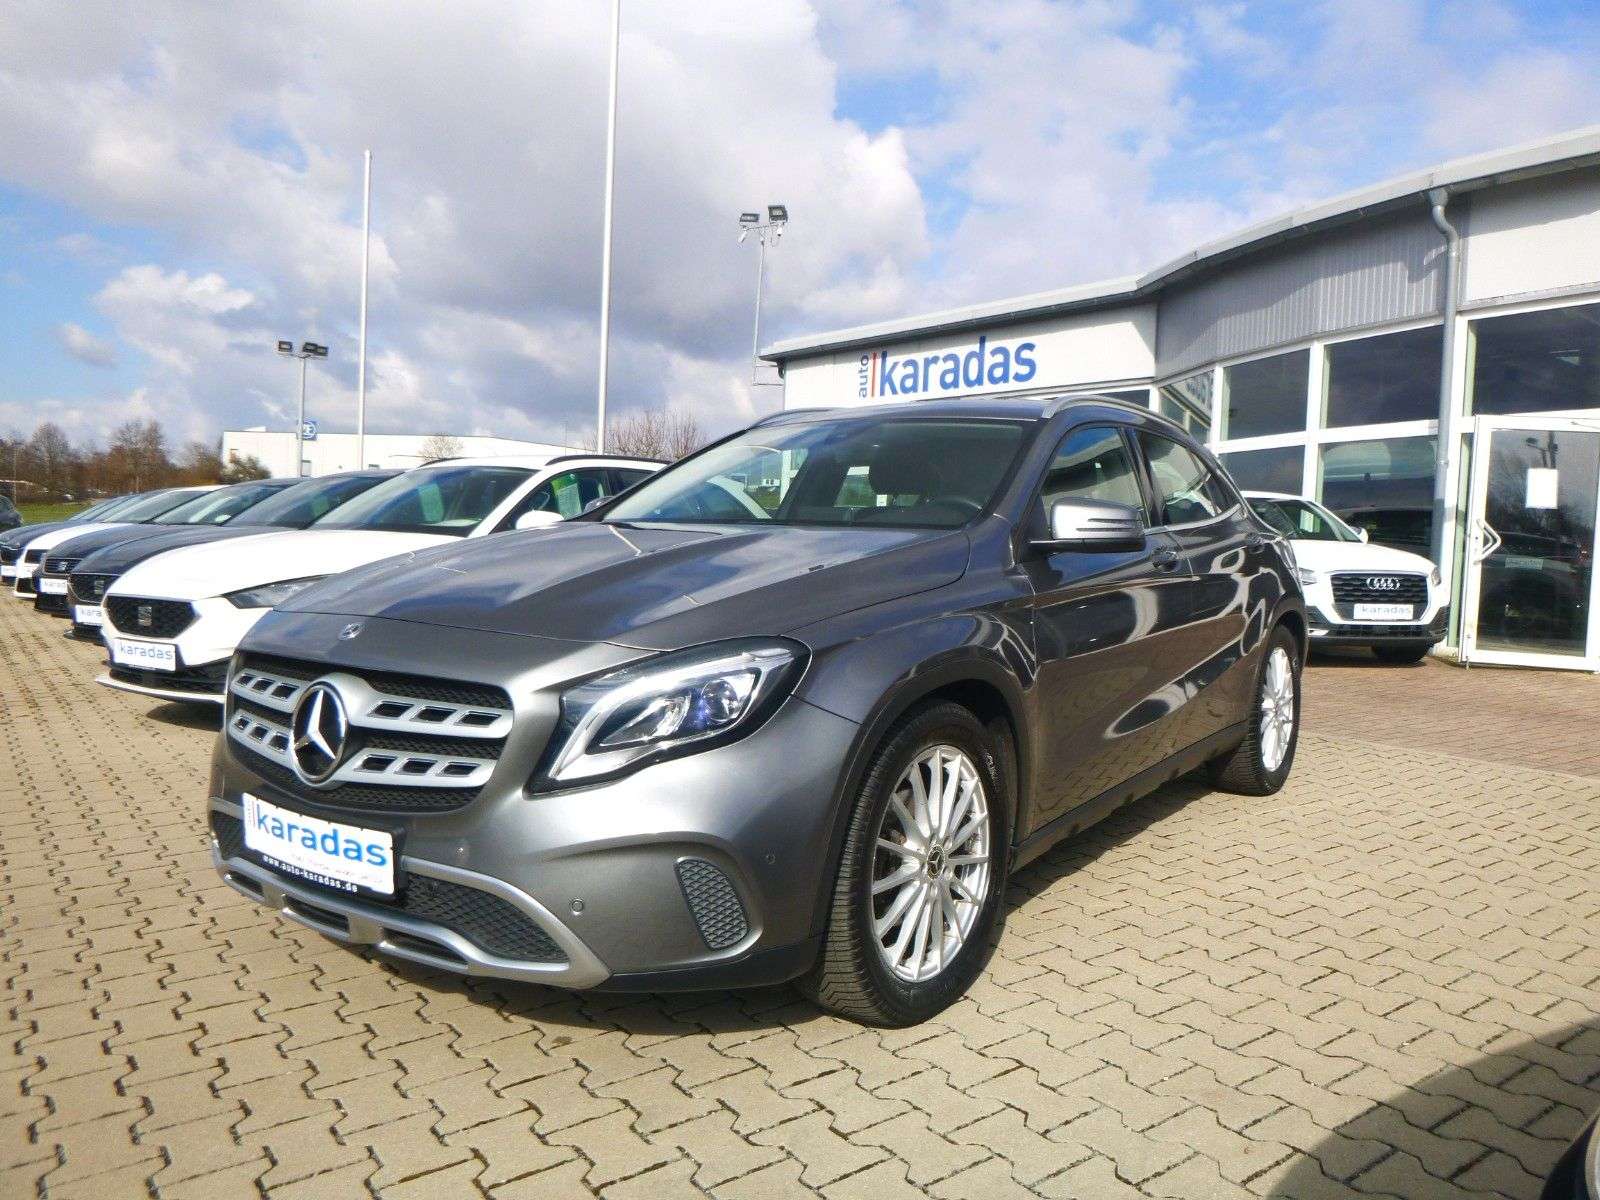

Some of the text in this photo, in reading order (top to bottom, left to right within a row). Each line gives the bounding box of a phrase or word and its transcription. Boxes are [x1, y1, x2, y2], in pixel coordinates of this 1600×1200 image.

[858, 335, 1037, 399] auto karadas
[120, 642, 174, 660] karadas
[256, 803, 387, 867] karadas
